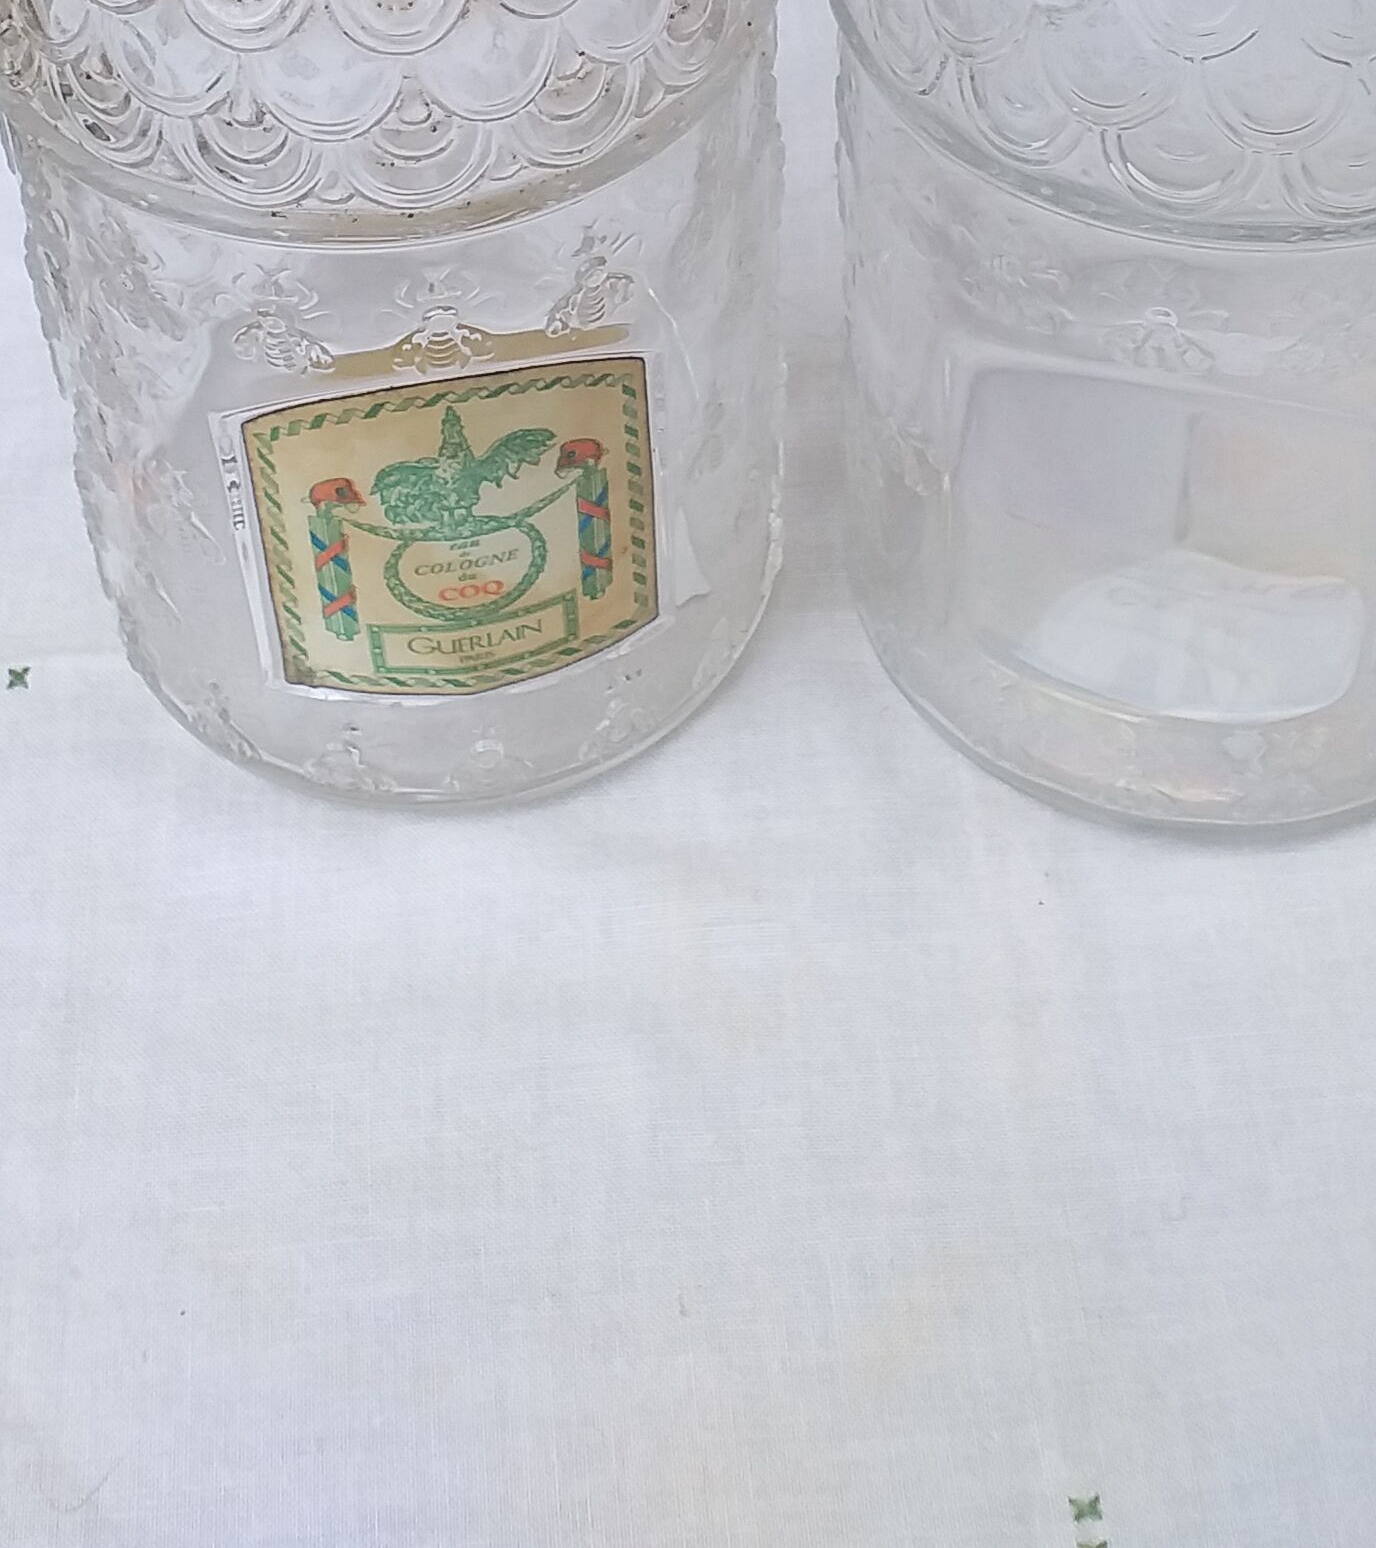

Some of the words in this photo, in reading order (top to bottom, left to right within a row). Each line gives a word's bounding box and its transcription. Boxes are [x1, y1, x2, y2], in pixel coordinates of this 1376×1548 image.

[414, 548, 520, 576] COLOGNE
[457, 572, 477, 582] du
[438, 580, 504, 602] COQ
[407, 618, 543, 655] GUERLAIN
